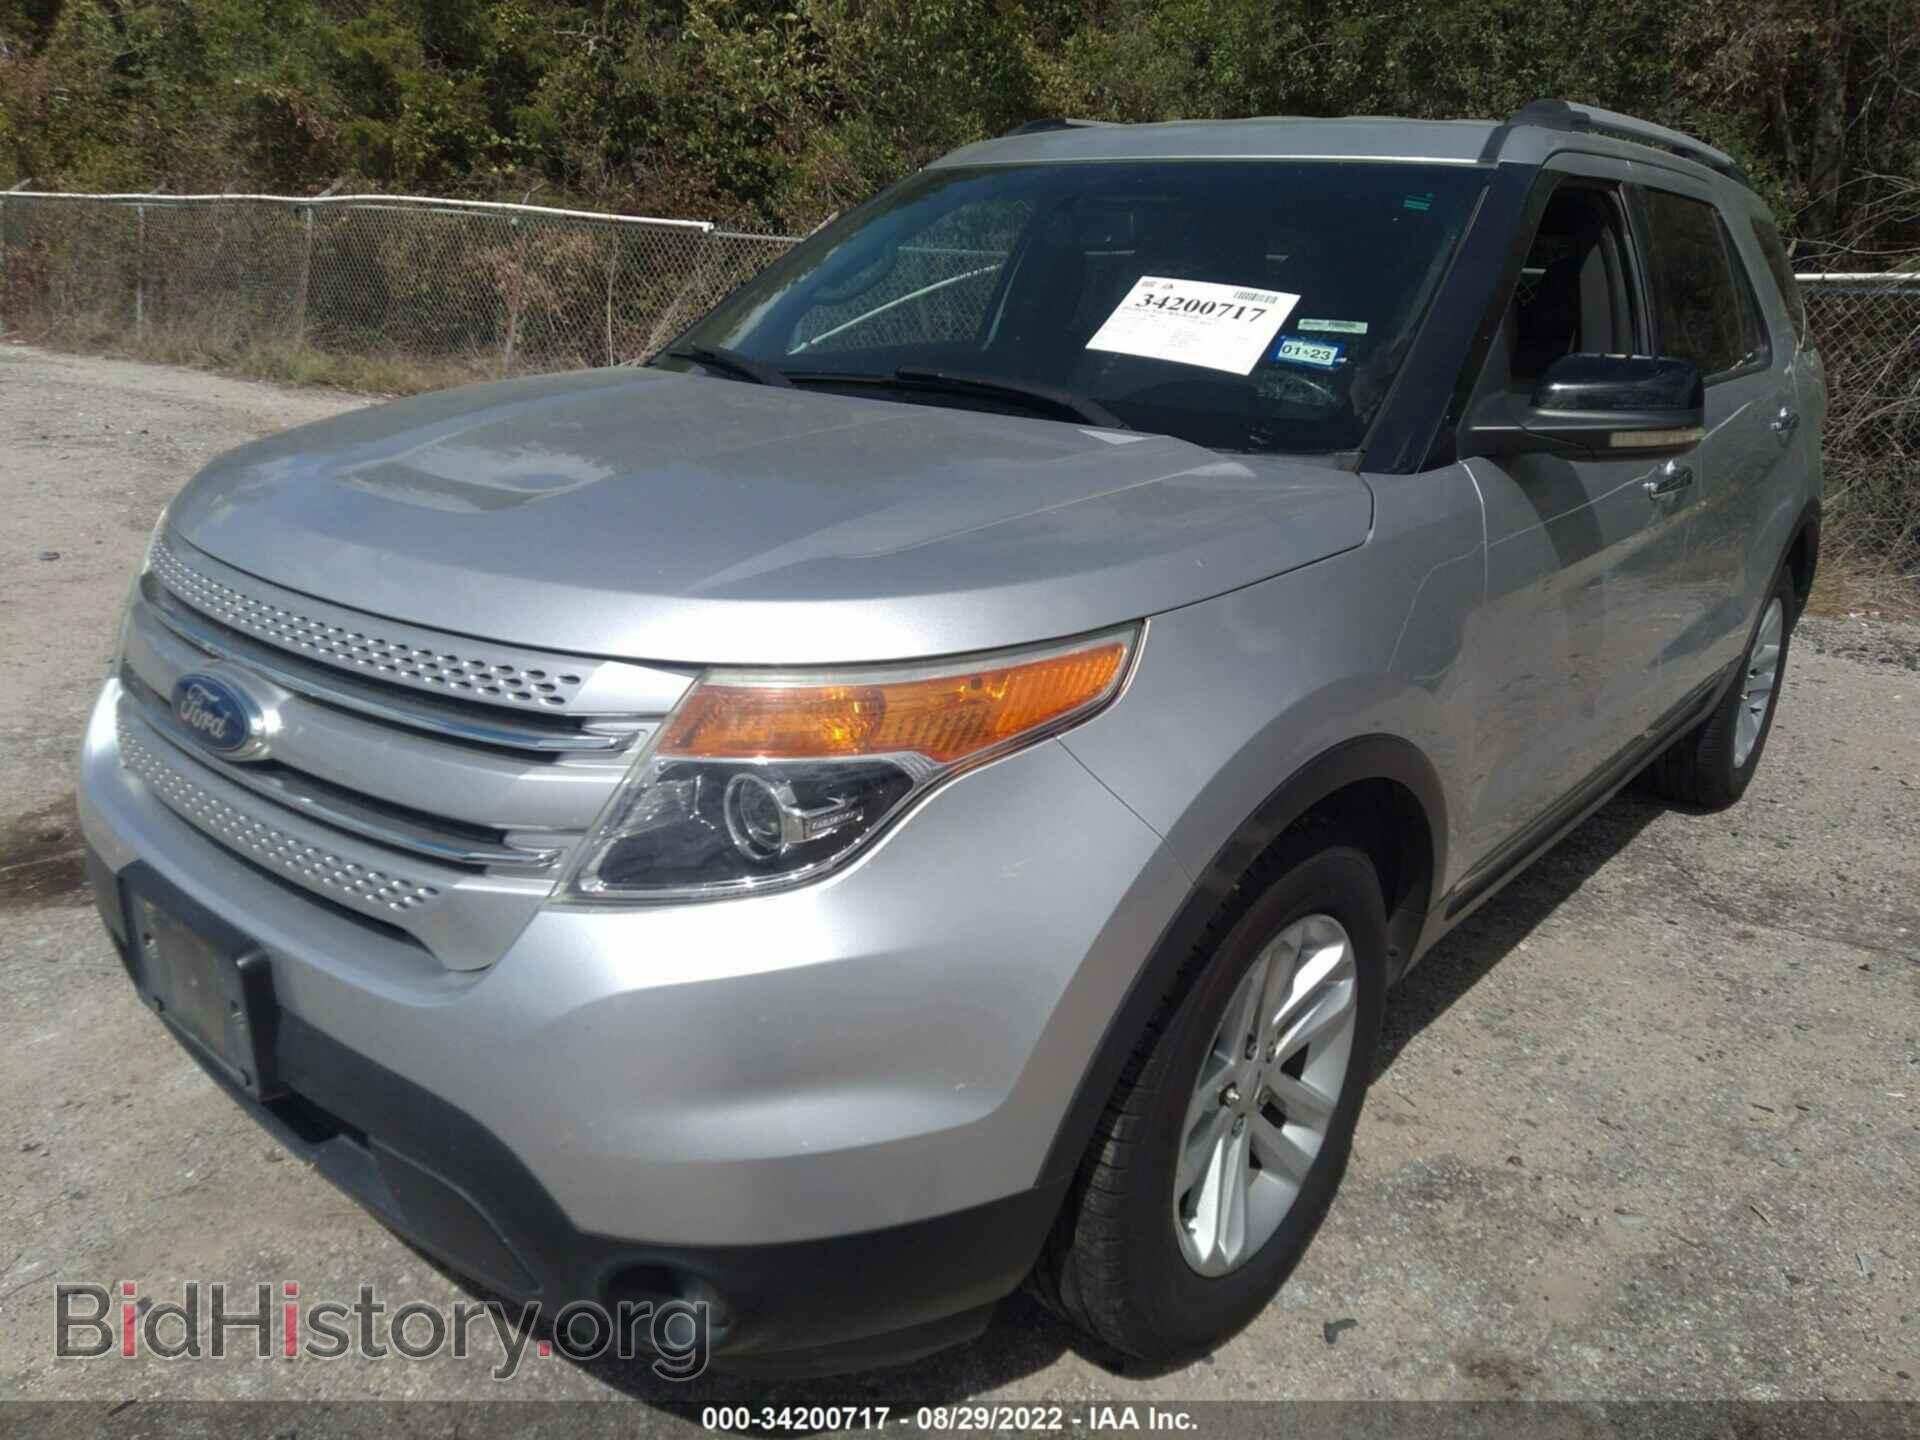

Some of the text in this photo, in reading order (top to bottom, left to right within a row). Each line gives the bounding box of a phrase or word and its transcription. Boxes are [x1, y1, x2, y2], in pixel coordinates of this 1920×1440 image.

[1136, 293, 1267, 322] 34200717
[1310, 349, 1331, 360] 23
[180, 683, 231, 739] Ford
